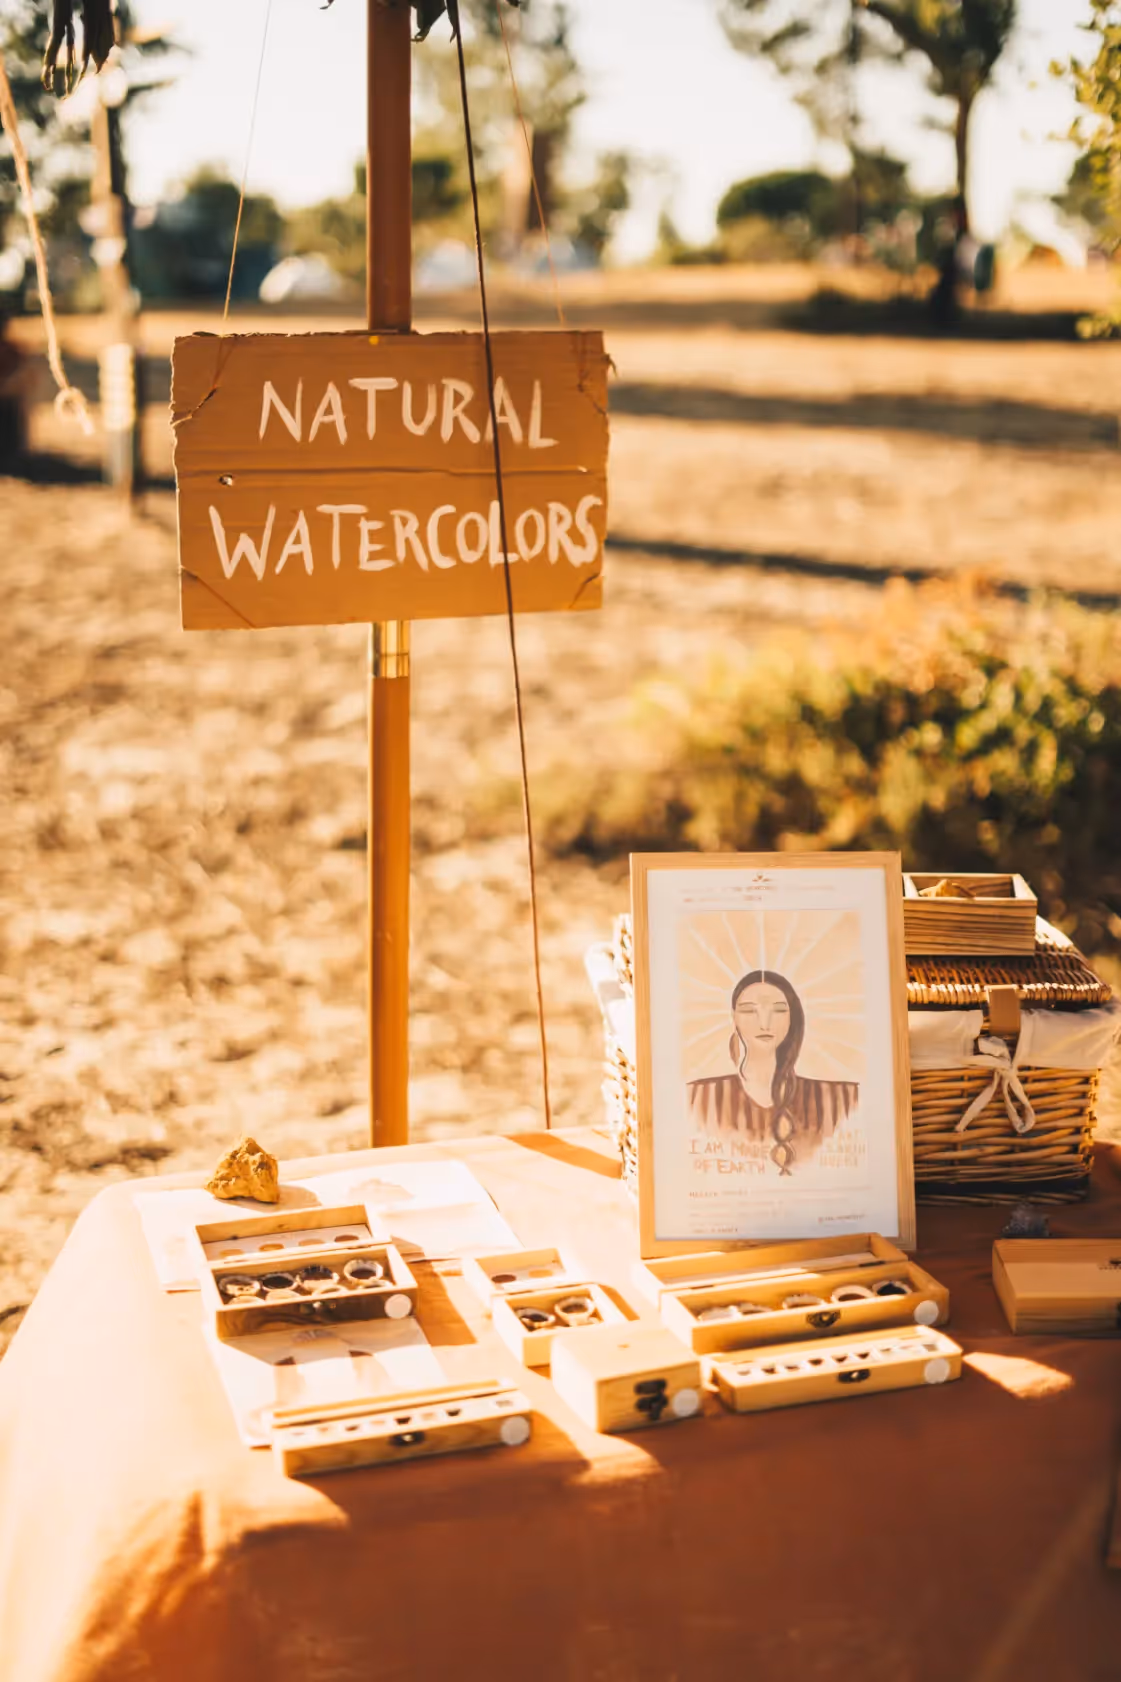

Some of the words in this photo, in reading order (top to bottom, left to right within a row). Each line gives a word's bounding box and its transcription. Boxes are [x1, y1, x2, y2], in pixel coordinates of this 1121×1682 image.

[259, 376, 559, 449] NATURAL
[208, 495, 603, 580] WATERCOLORS
[704, 1141, 724, 1155] AM
[716, 1159, 766, 1175] EARTH
